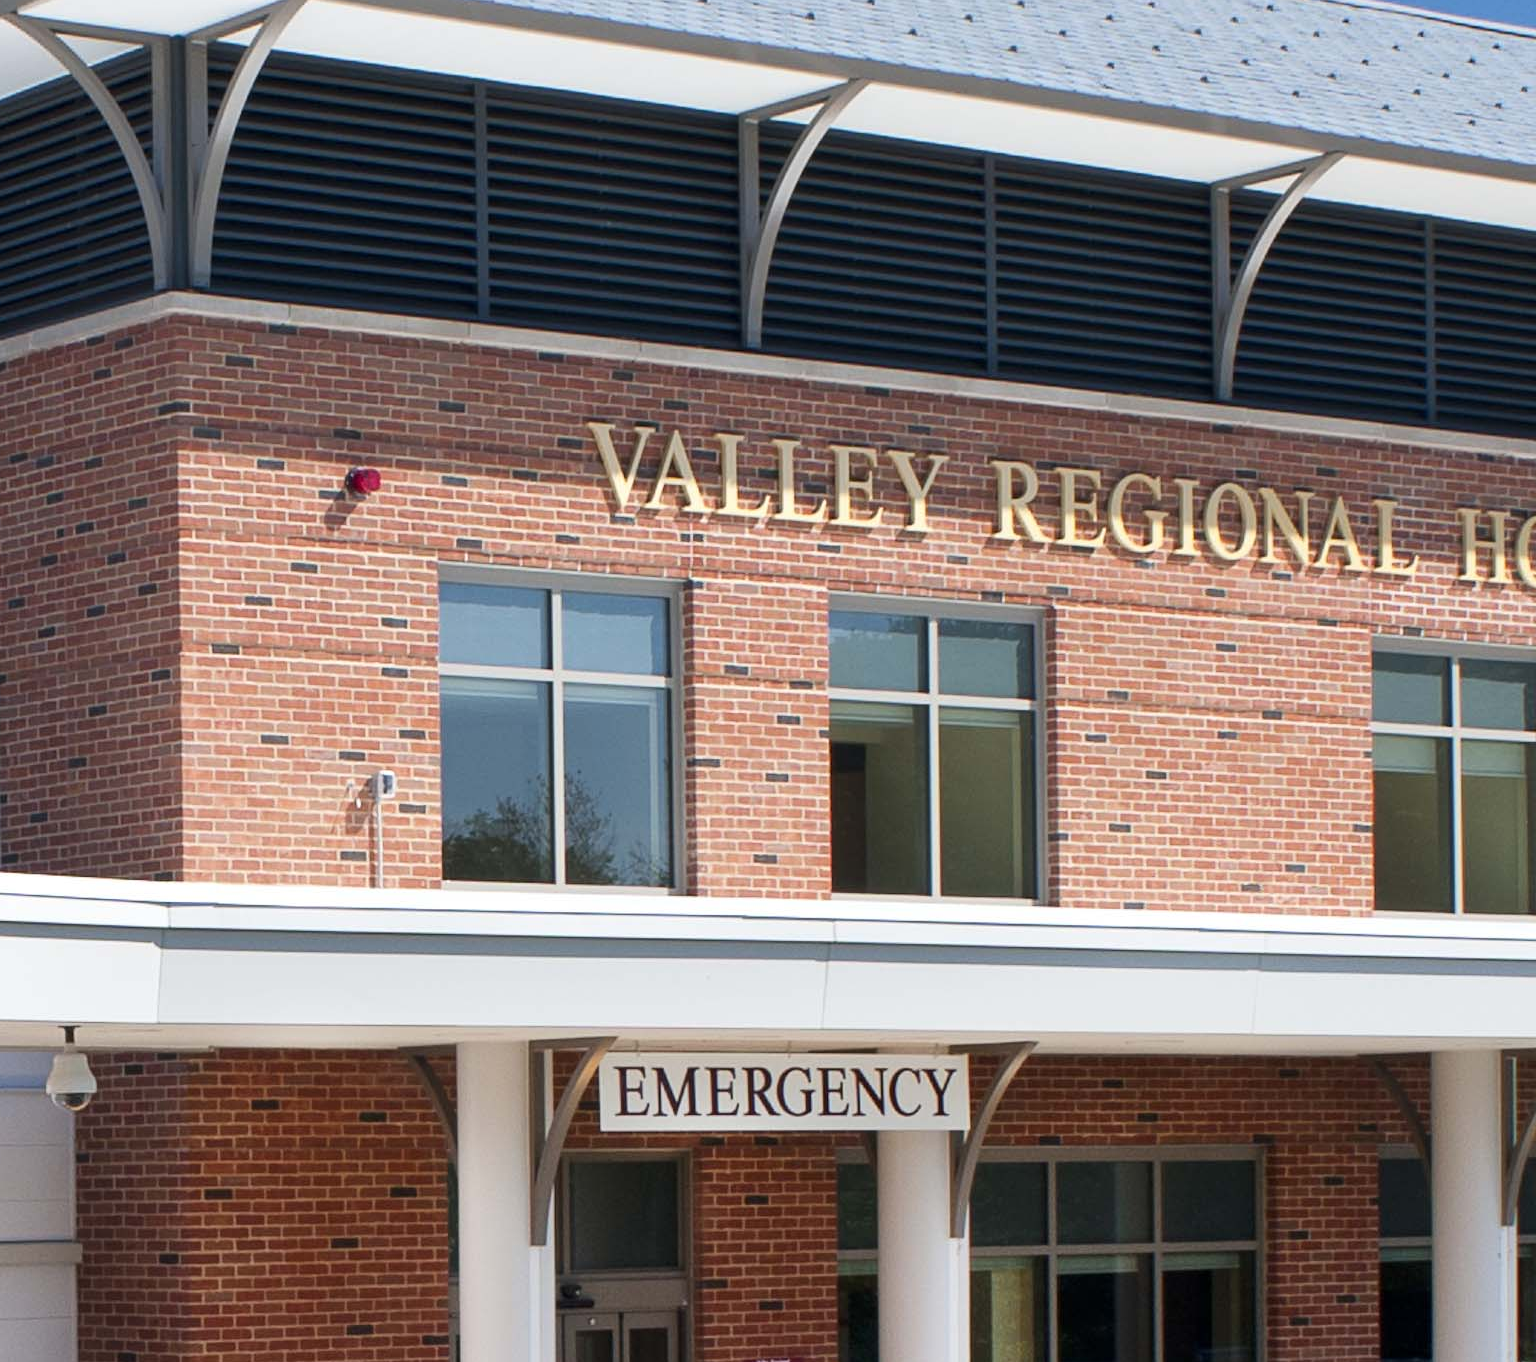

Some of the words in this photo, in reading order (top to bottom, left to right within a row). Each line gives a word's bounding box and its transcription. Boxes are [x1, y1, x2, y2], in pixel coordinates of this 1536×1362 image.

[586, 421, 950, 533] VALLEY
[989, 459, 1420, 577] REGIONAL
[613, 1064, 958, 1118] EMERGENCY
